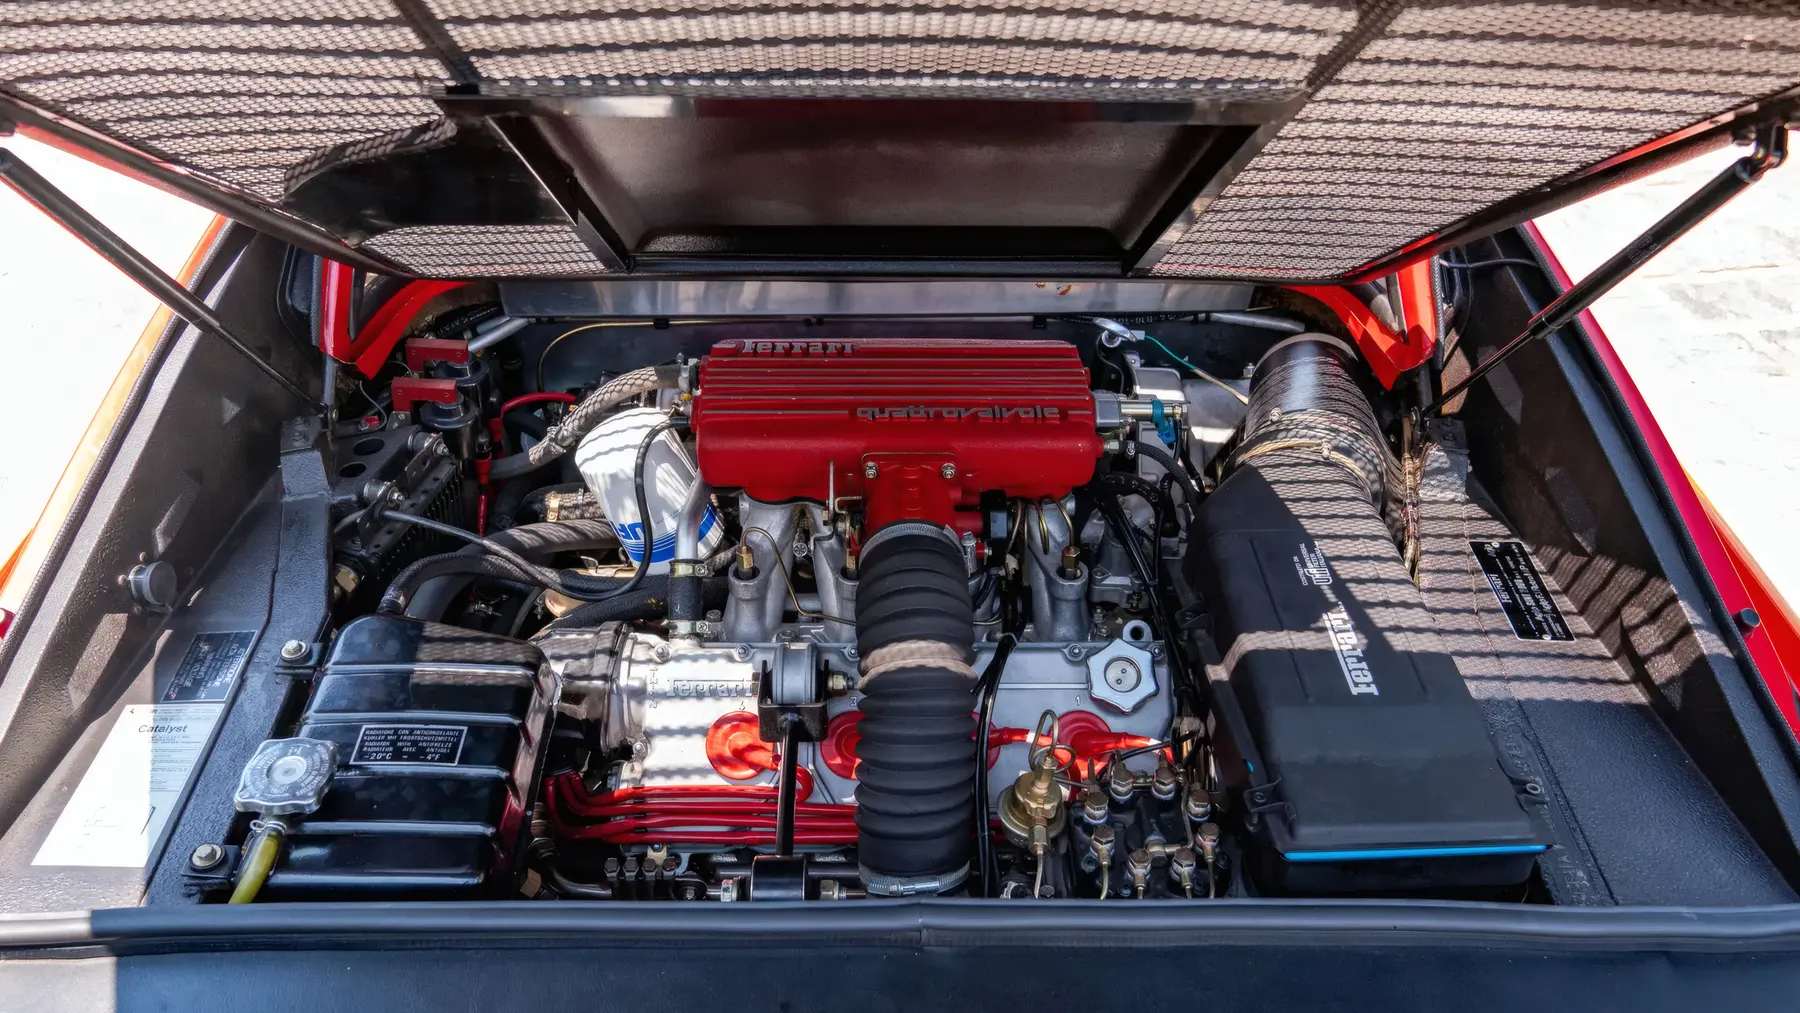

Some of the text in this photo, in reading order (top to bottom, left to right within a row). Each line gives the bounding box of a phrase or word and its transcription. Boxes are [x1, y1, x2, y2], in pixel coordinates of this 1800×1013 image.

[743, 339, 853, 354] Ferrari
[856, 405, 1060, 420] quattrovalvole
[1487, 573, 1512, 604] Ferrari
[1322, 612, 1379, 695] Ferrari
[665, 678, 753, 698] Ferrari
[1074, 694, 1082, 707] 1
[138, 724, 188, 734] Catalyst
